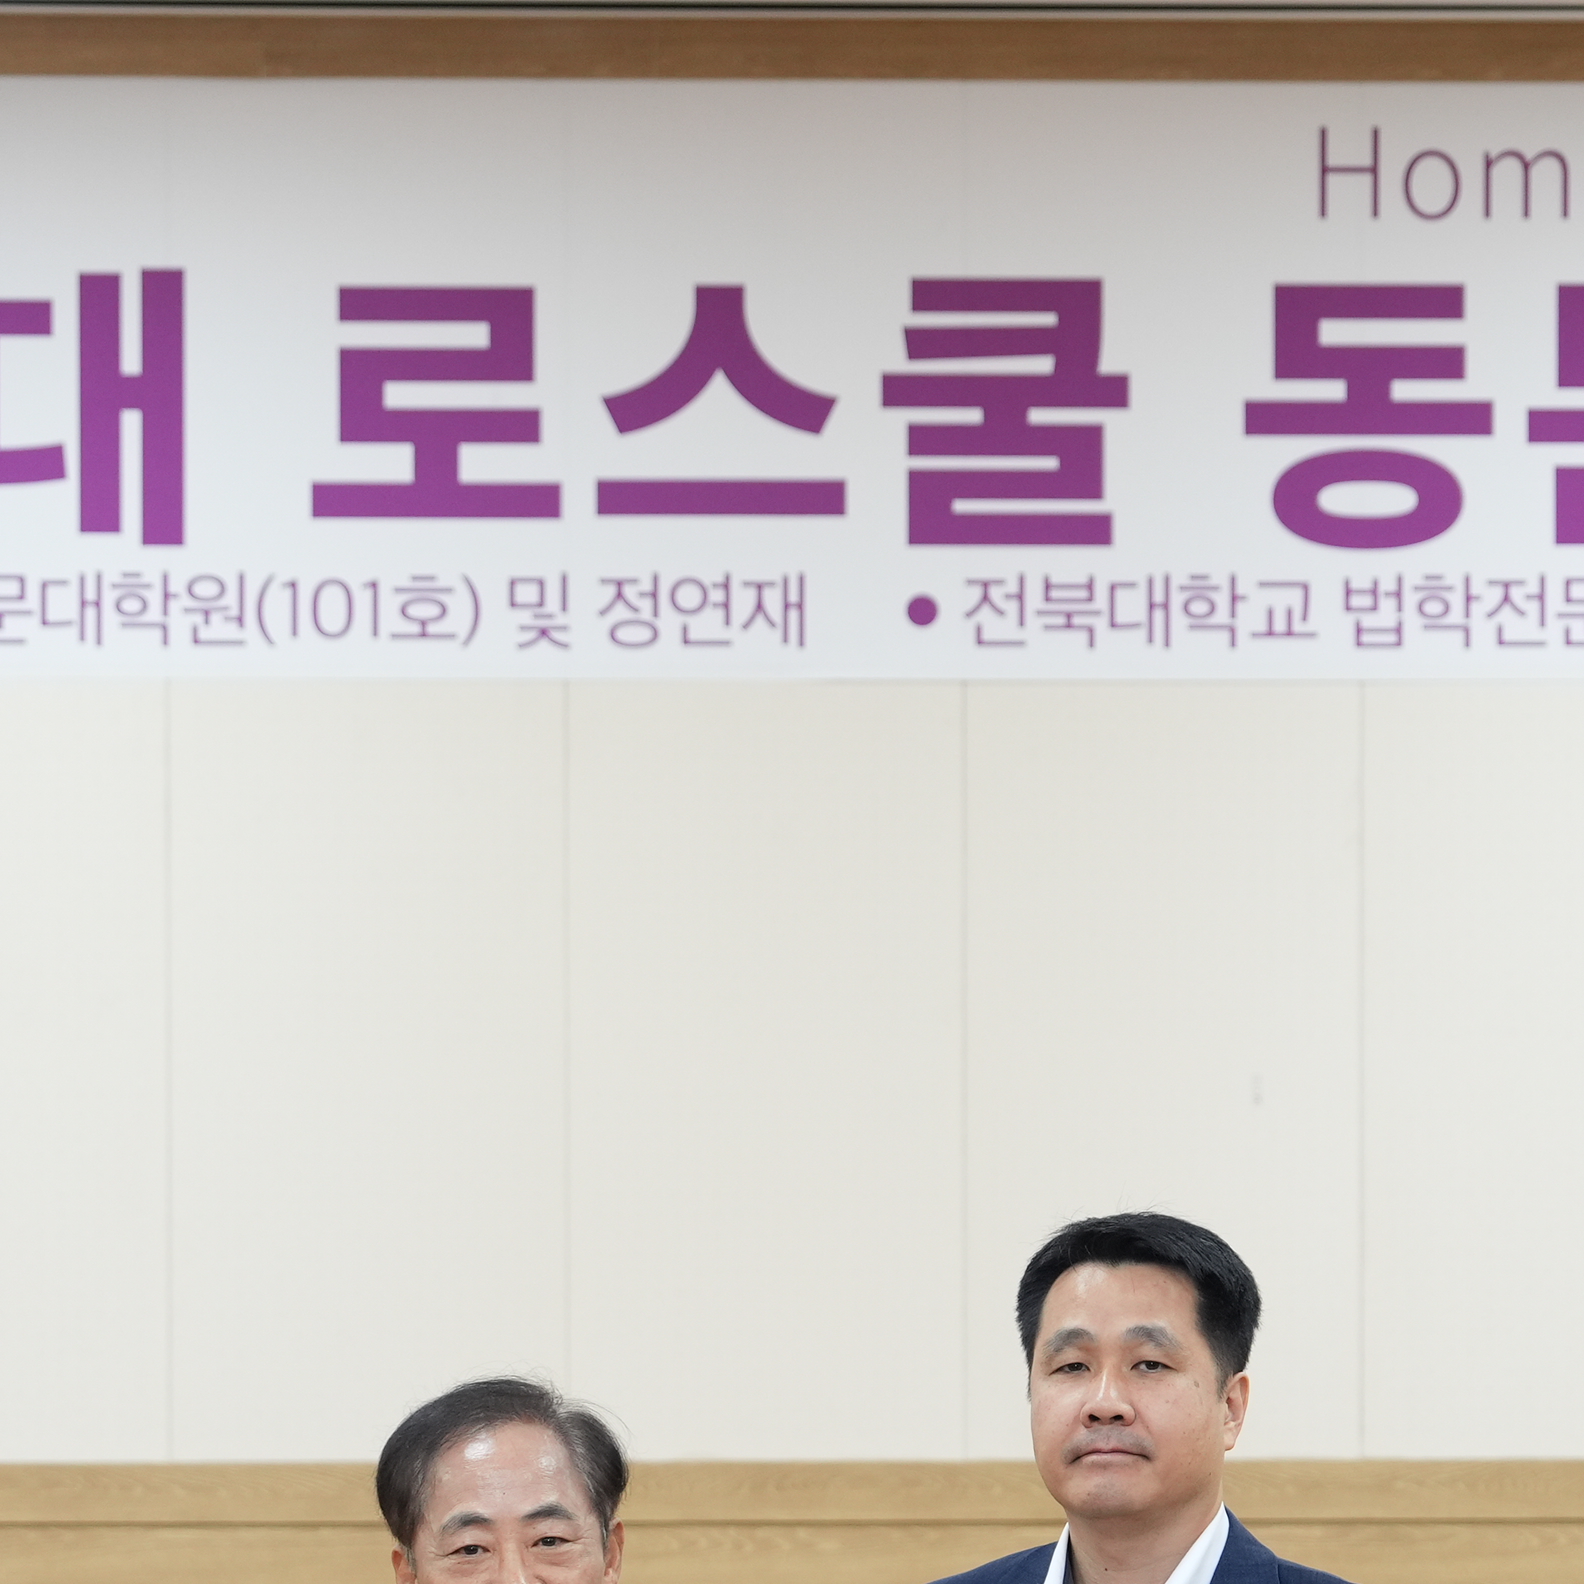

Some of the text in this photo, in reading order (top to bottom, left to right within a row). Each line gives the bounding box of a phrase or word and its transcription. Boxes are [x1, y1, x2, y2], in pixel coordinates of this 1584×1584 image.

[311, 278, 1130, 547] 로스쿨
[508, 574, 571, 650] 및
[598, 574, 808, 649] 정연재
[961, 574, 1314, 650] 전북대학교
